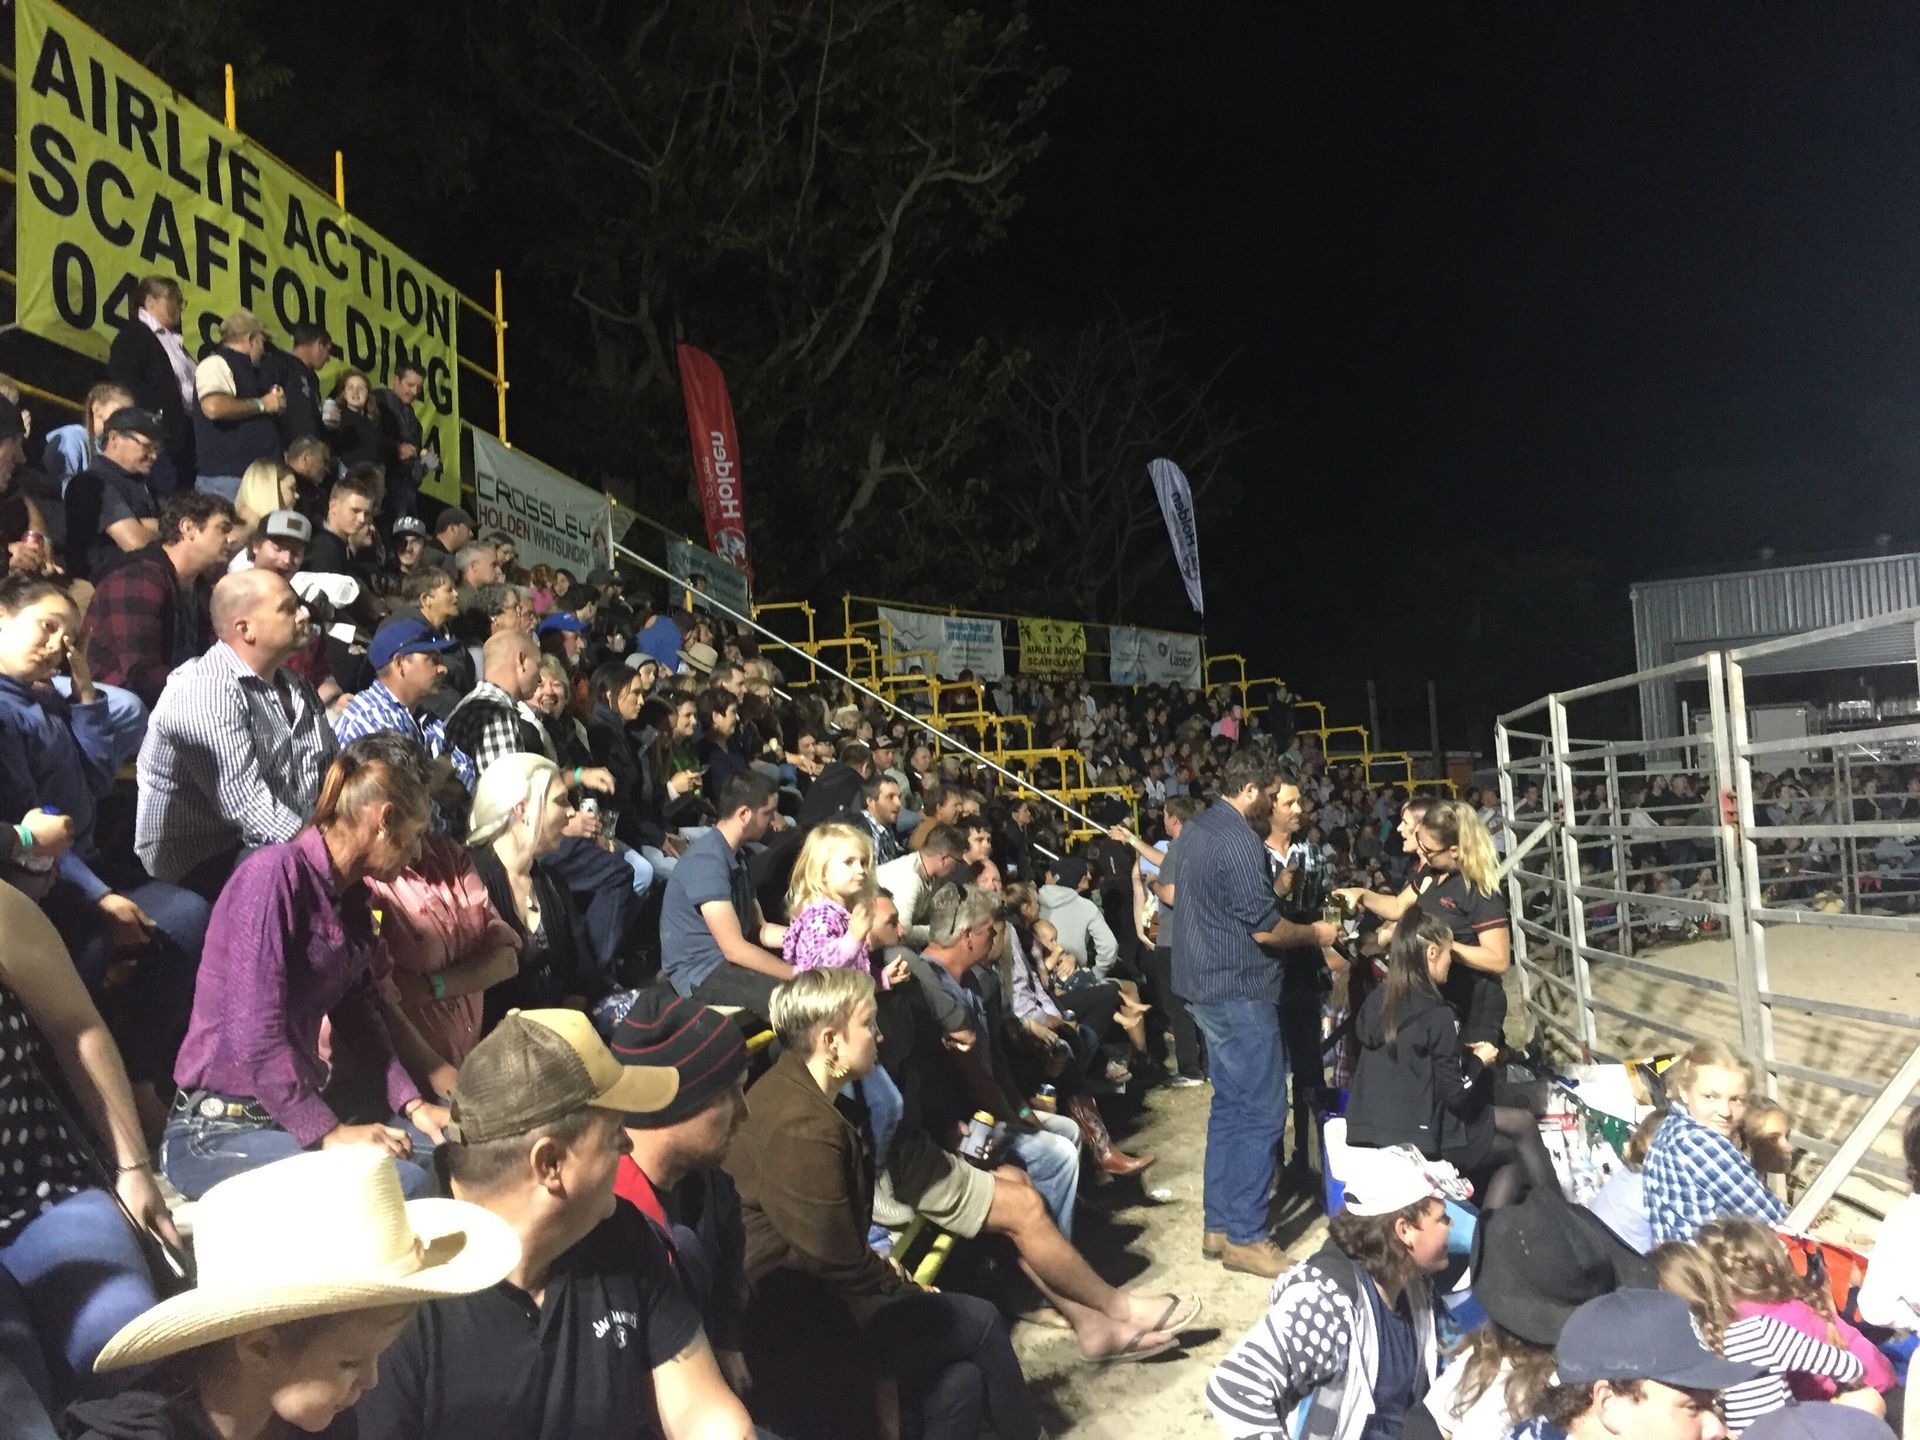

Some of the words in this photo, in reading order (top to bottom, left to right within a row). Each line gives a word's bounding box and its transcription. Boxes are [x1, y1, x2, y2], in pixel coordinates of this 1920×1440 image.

[30, 26, 264, 230] AIRLIE
[283, 193, 450, 347] ACTION
[477, 471, 591, 544] CROSSLEY
[478, 503, 532, 543] HOLDEN
[532, 525, 591, 568] WHITSUNDAY
